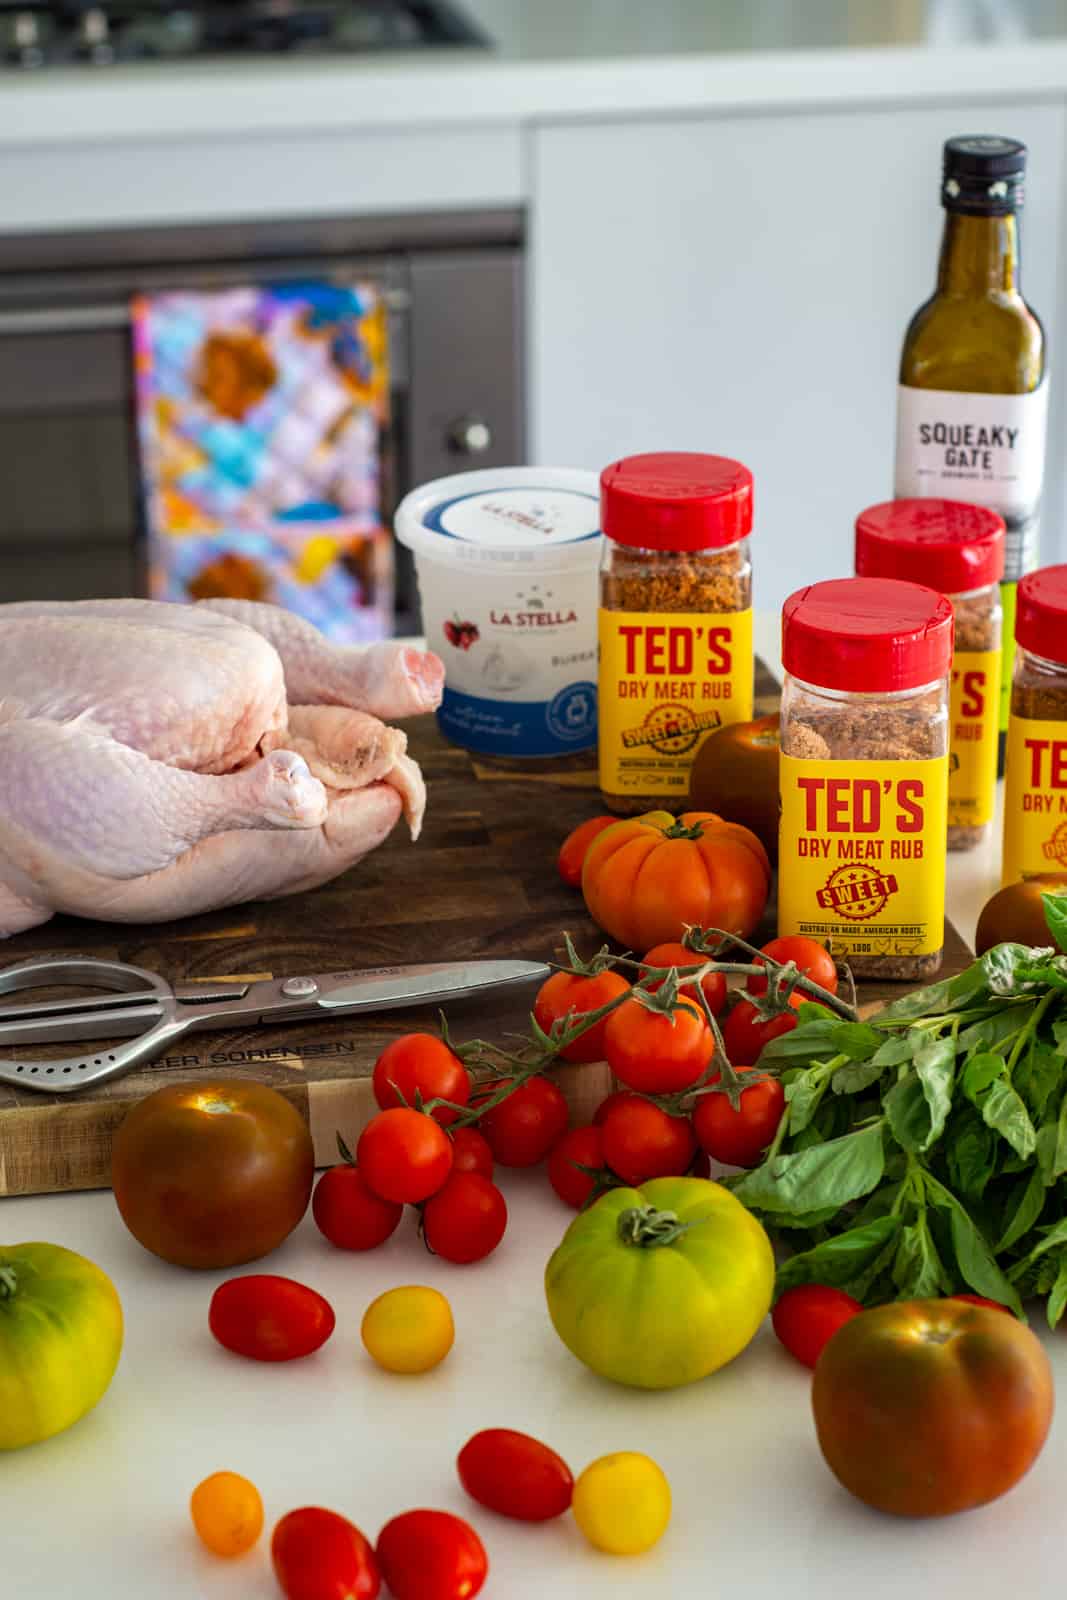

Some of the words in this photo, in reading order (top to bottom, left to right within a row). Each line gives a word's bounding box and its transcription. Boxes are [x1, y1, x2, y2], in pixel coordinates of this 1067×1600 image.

[919, 422, 1019, 449] SQUEAKY
[945, 449, 992, 469] GATE
[490, 610, 512, 625] LA
[516, 611, 577, 627] STELLA
[618, 626, 732, 675] TED'S
[618, 681, 648, 699] DRY
[655, 682, 697, 699] MEAT
[702, 682, 732, 699] RUB
[797, 777, 925, 833] TED'S
[1023, 794, 1054, 812] DRY
[798, 838, 832, 858] DRY
[838, 840, 884, 860] MEAT
[890, 840, 924, 860] RUB
[822, 877, 890, 906] SWEET
[800, 924, 839, 934] AUSTRALAN
[148, 1055, 199, 1069] EER
[211, 1039, 355, 1063] SORENSEN
